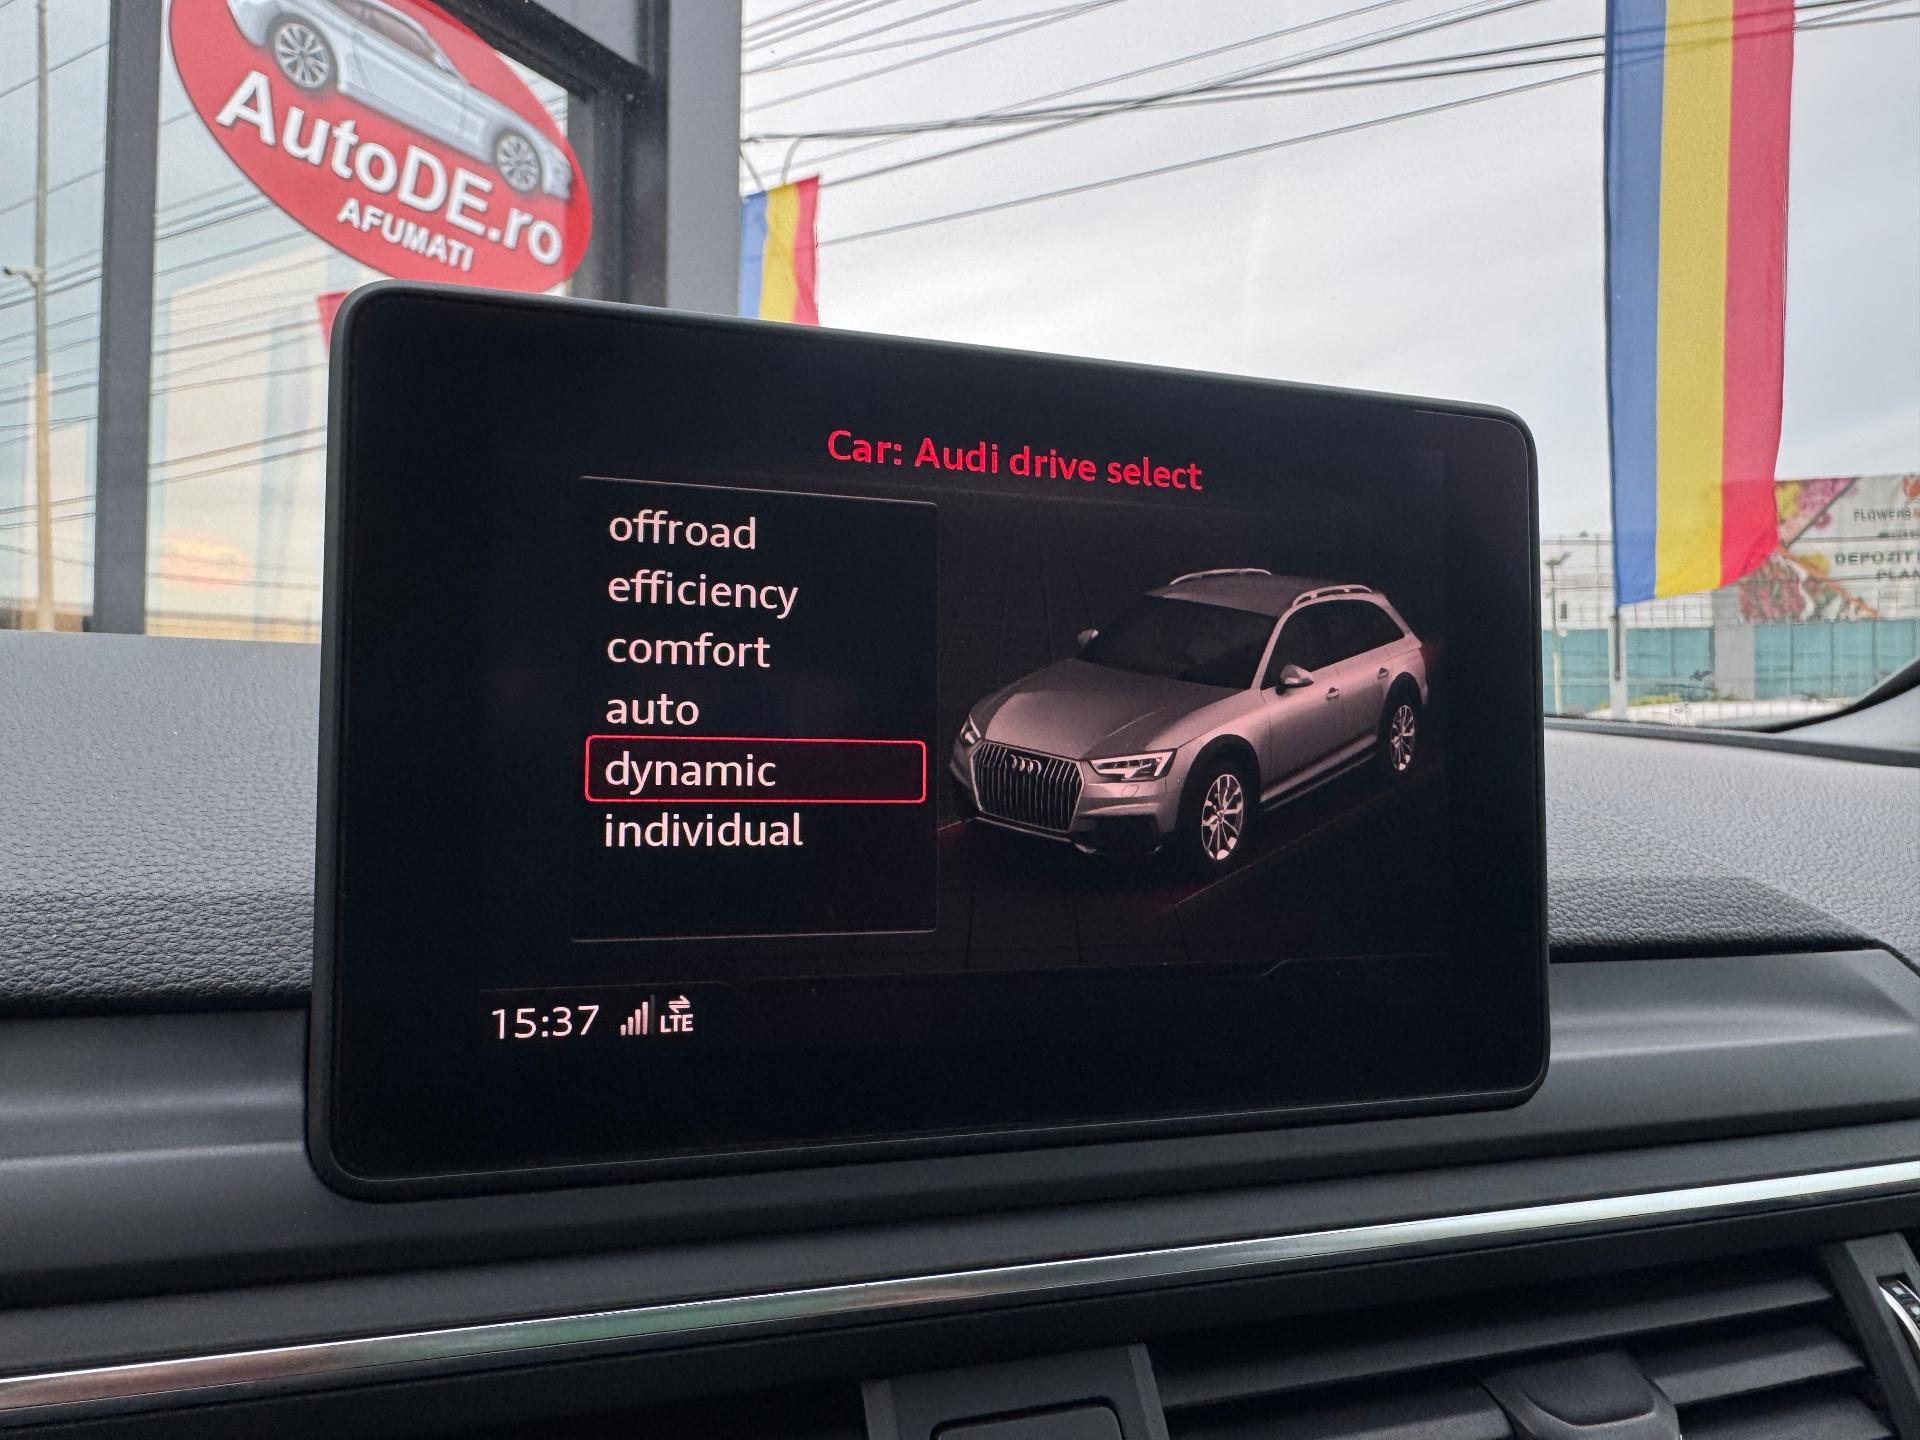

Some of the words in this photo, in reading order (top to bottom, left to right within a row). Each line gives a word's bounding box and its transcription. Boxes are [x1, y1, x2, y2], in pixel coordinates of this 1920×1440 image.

[215, 70, 563, 266] AutoDE.ro
[337, 198, 475, 272] AFUMATI
[827, 429, 903, 466] Car:
[914, 437, 999, 474] Audi
[1009, 445, 1097, 482] drive
[1107, 457, 1203, 490] select
[608, 509, 757, 550] offroad
[607, 569, 799, 619] efficiency
[606, 632, 771, 668] comfort
[605, 693, 700, 725] auto
[604, 750, 776, 795] dynamic
[604, 812, 804, 847] individual
[492, 1004, 600, 1040] 15:37
[660, 1013, 694, 1033] LTE
